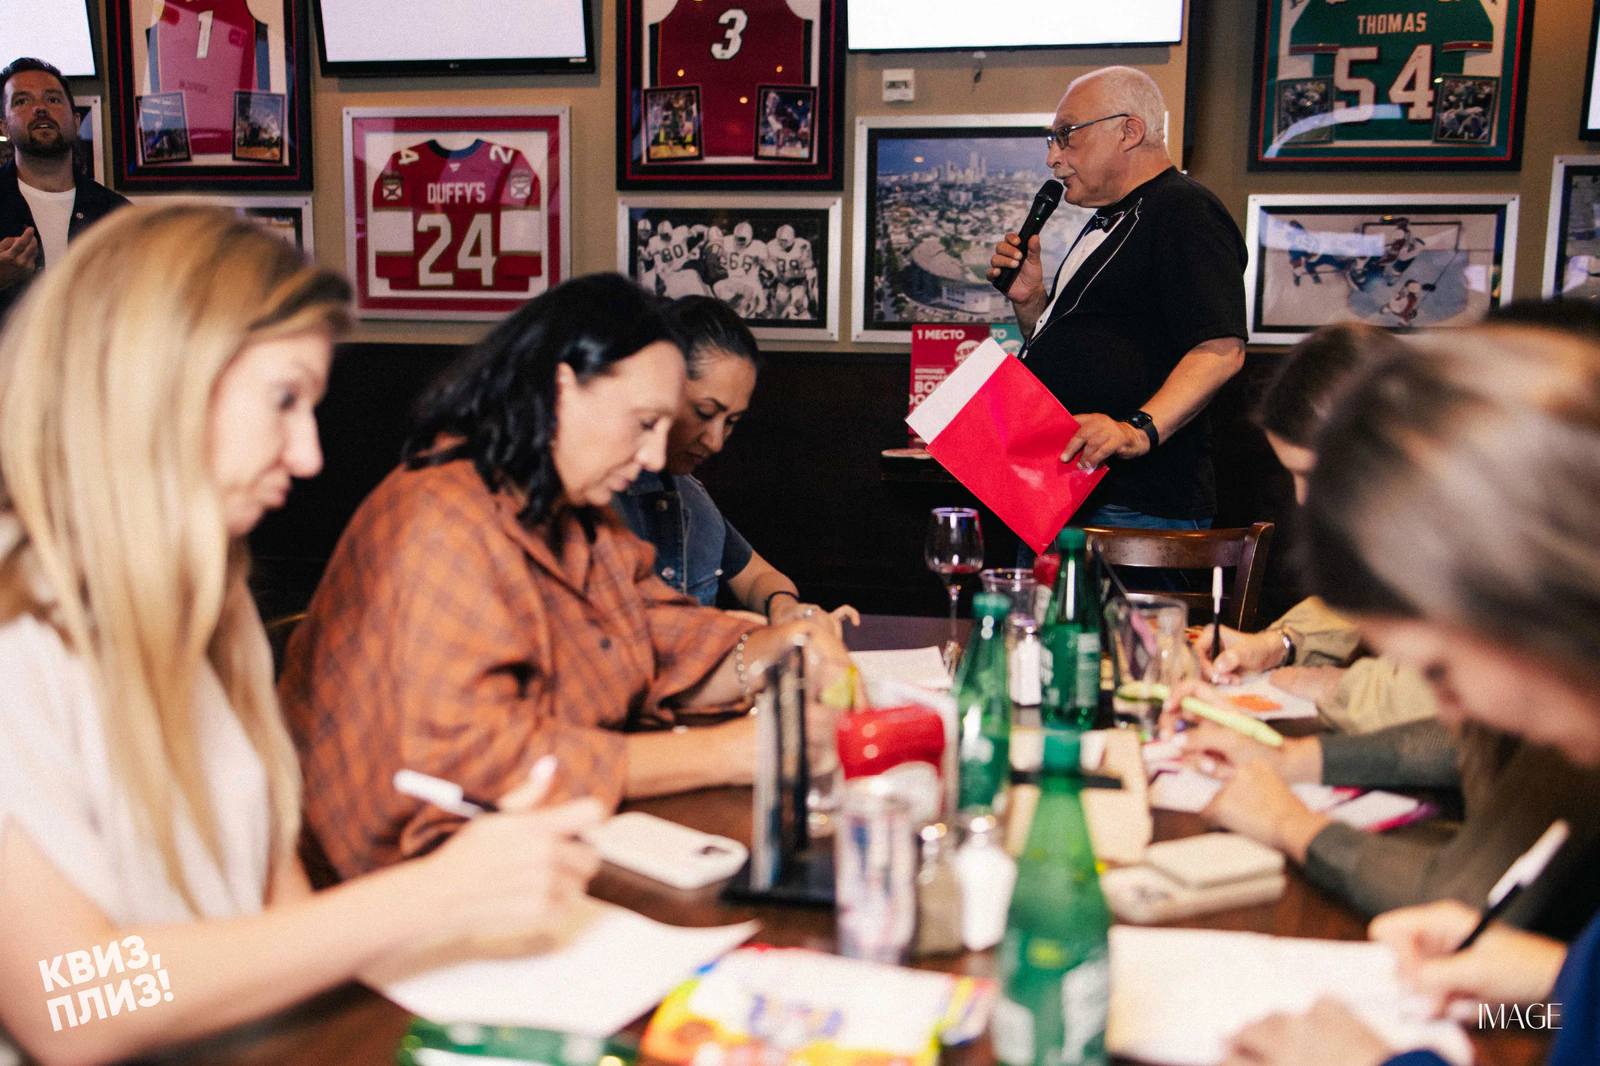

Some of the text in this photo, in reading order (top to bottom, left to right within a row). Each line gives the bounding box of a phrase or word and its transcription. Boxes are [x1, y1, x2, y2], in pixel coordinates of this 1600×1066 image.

[195, 9, 214, 59] 1
[710, 8, 748, 60] 3
[1357, 11, 1428, 35] THOMAS
[1333, 42, 1435, 123] 54
[427, 181, 487, 204] DUFFY'S
[416, 211, 497, 287] 24
[917, 329, 966, 340] 1 МЕСТО
